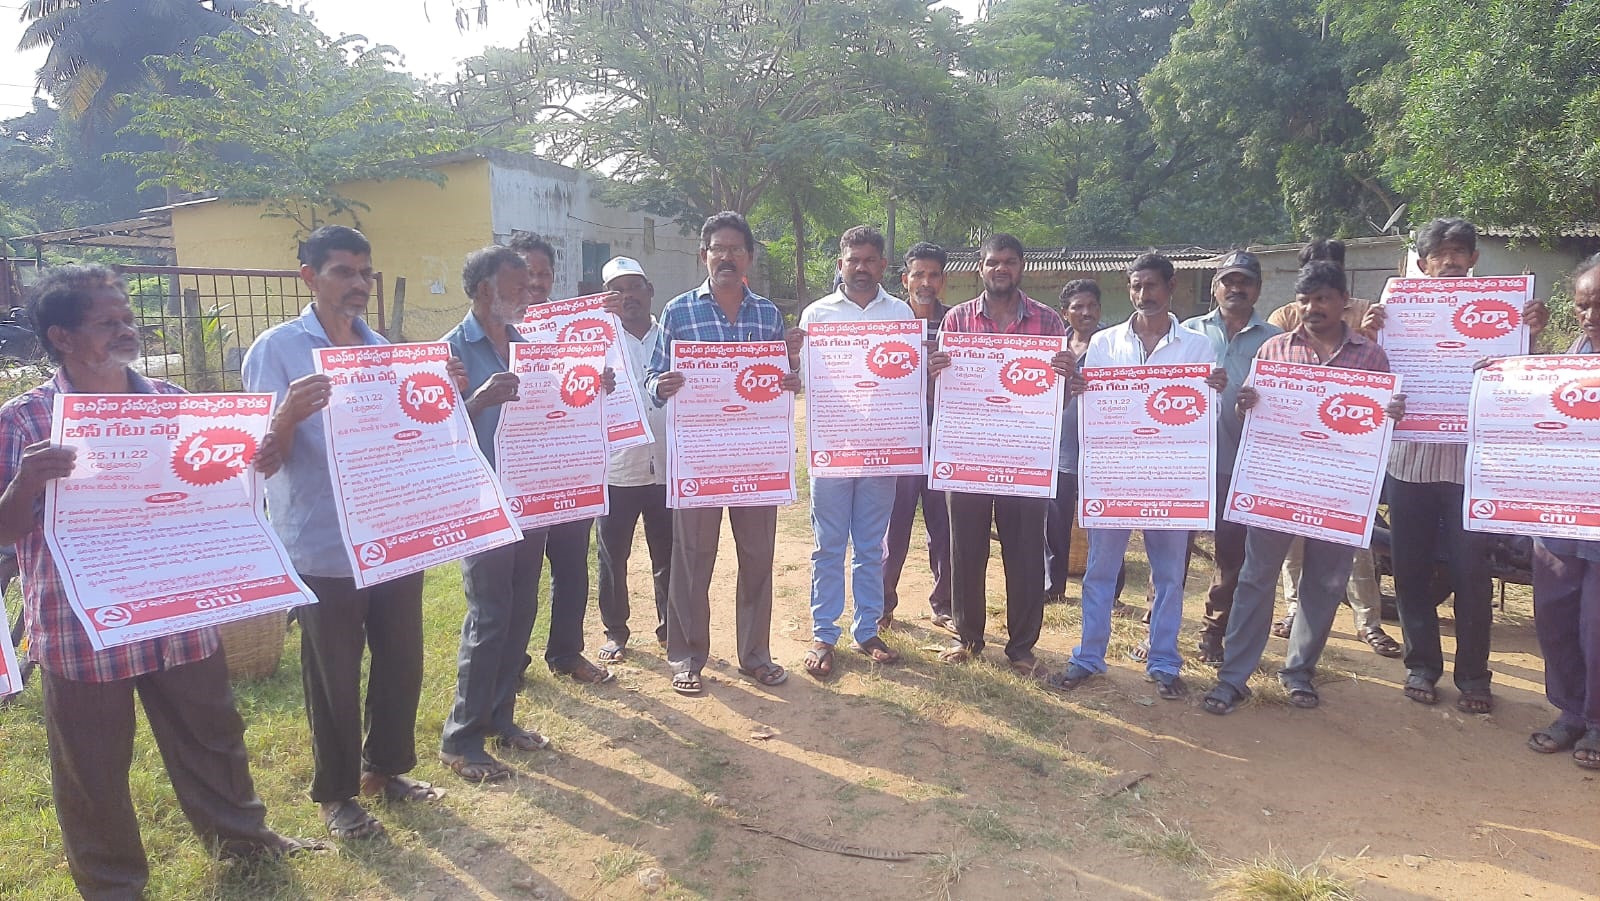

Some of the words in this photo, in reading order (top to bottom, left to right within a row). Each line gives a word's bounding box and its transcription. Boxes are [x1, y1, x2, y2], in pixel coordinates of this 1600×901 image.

[1460, 304, 1513, 329] ధర్నా
[872, 346, 914, 369] ధర్నా
[350, 372, 375, 384] గేటు
[377, 371, 397, 384] వద్ద
[741, 369, 782, 393] ధర్నా
[1006, 361, 1050, 388] ధర్నా
[565, 370, 597, 396] ధర్నా
[1106, 383, 1129, 392] గేటు
[1131, 383, 1150, 393] వద్ద
[345, 393, 384, 404] 25.11.22
[405, 380, 452, 411] ధర్నా
[1266, 395, 1303, 406] 25.11.22
[1153, 390, 1201, 416] ధర్నా
[1326, 396, 1377, 429] ధర్నా
[105, 422, 145, 437] గేటు
[149, 422, 180, 441] వద్ద
[1438, 422, 1468, 431] CITU
[87, 449, 149, 460] 25.11.22
[183, 435, 247, 471] ధర్నా
[863, 457, 889, 465] CITU
[987, 474, 1014, 483] CITU
[732, 483, 757, 493] CITU
[553, 498, 576, 510] CITU
[1140, 508, 1169, 517] CITU
[1291, 513, 1324, 525] CITU
[1539, 514, 1577, 524] CITU
[432, 529, 467, 547] CITU
[195, 593, 242, 609] CITU
